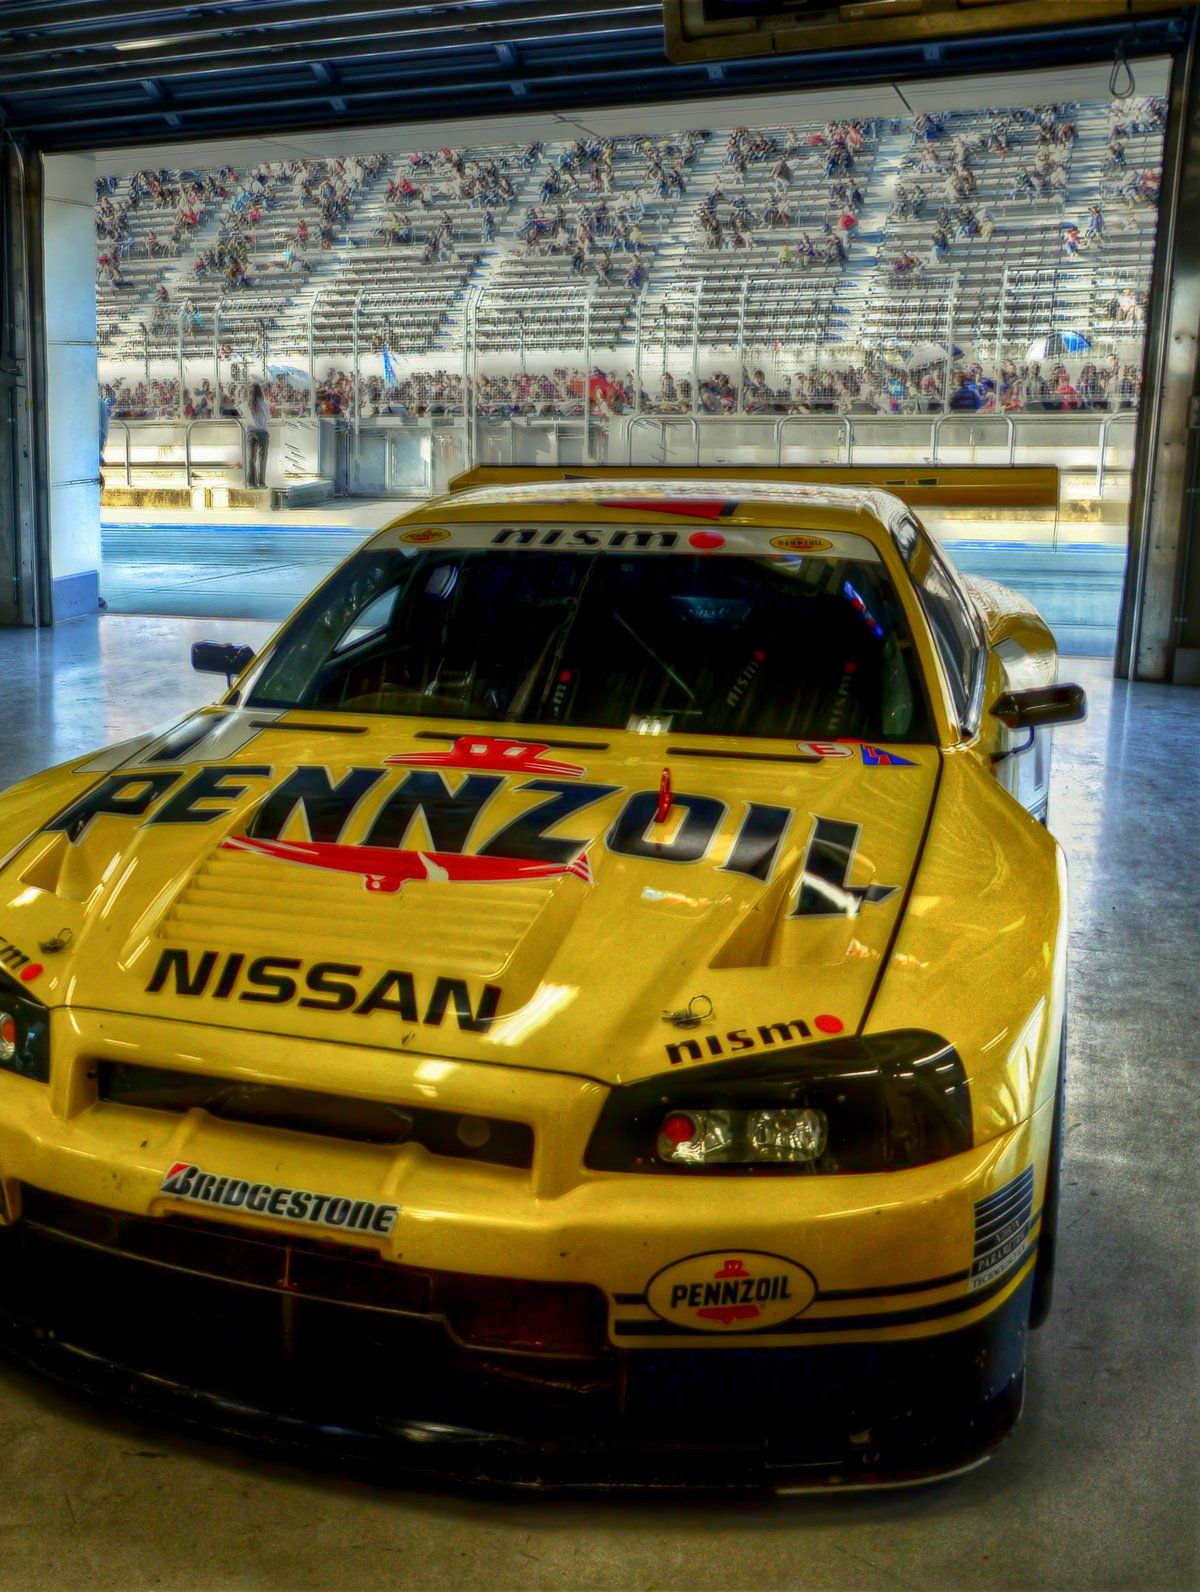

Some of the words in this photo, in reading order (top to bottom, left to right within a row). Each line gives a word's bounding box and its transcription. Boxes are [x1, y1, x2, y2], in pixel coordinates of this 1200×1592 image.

[43, 764, 904, 920] PENNZOIL
[144, 947, 503, 1034] NISSAN
[160, 1163, 399, 1233] BRIDGESTONE
[670, 1275, 793, 1309] PENNZOIL
